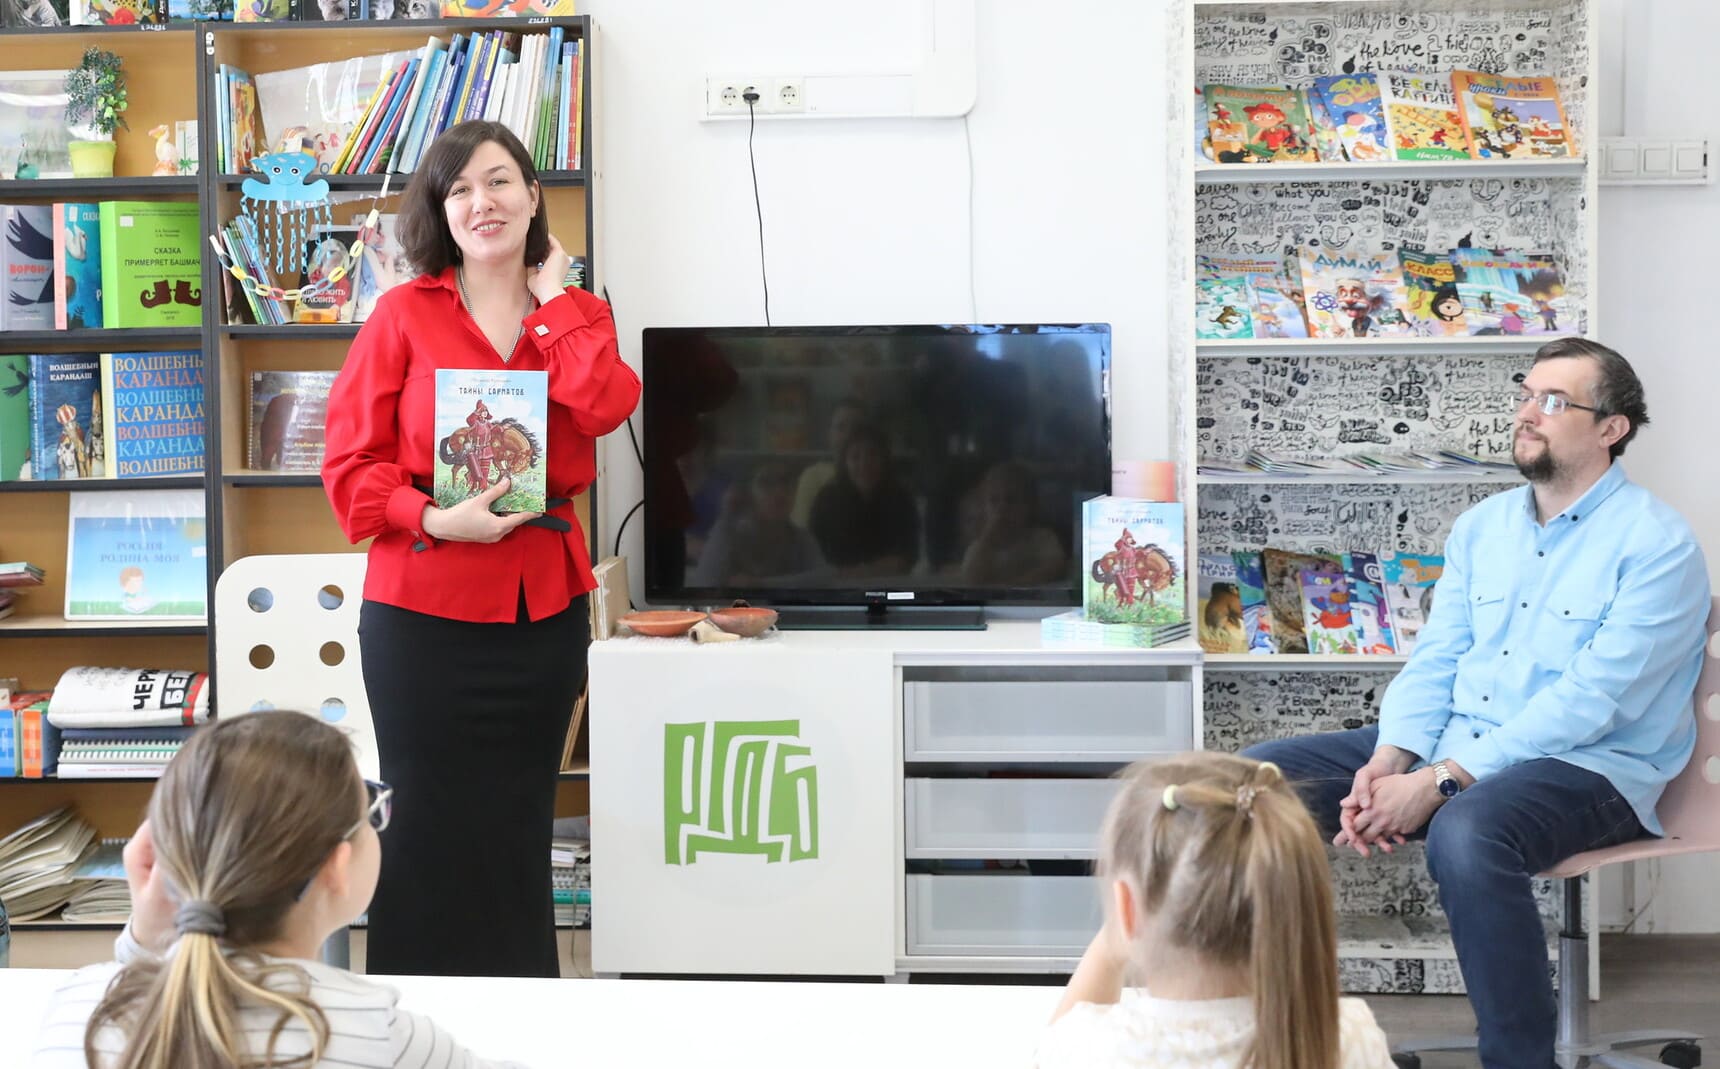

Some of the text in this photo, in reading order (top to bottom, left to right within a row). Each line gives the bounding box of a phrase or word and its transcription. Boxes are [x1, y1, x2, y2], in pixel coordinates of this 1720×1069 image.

[154, 247, 181, 255] СКАЗКА
[124, 259, 168, 267] ПРИМЕРЯЕТ
[50, 373, 92, 381] КАРАНДАШ
